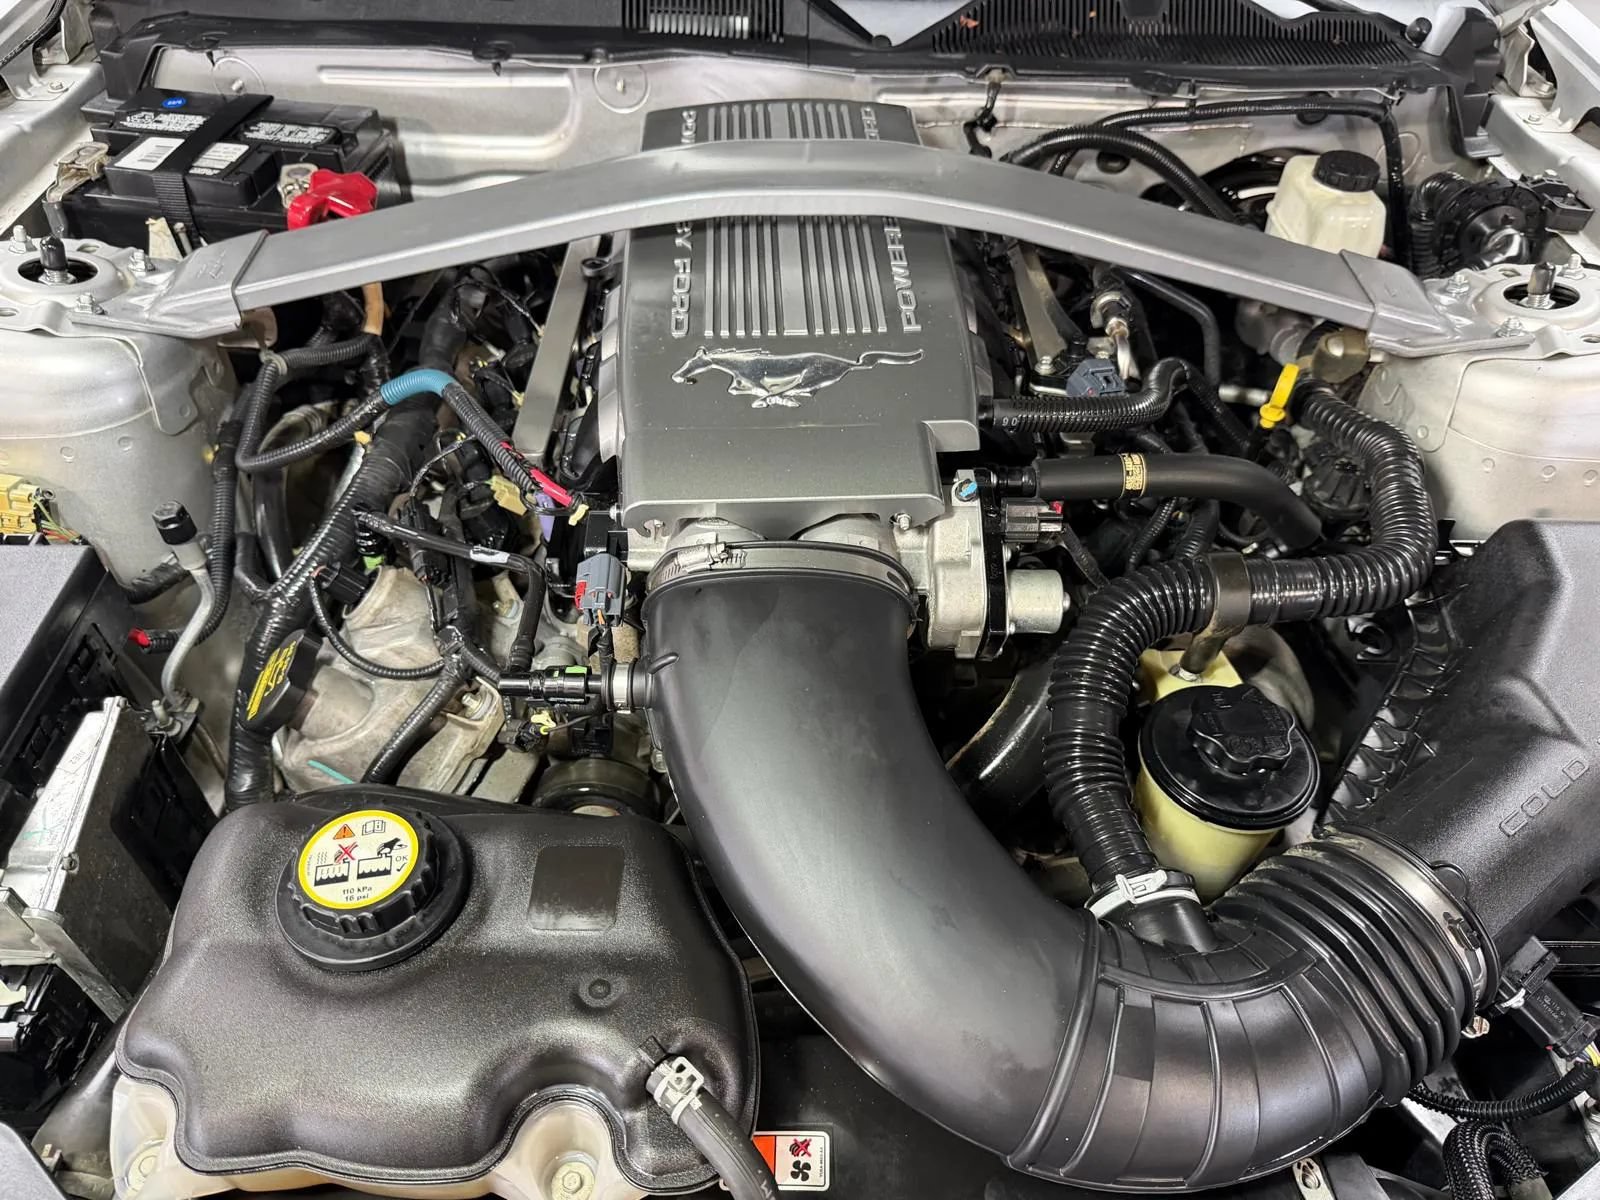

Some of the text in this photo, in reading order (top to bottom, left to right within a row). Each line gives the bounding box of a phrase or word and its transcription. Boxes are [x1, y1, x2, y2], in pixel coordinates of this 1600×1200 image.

[882, 216, 922, 333] POWERE
[670, 257, 692, 340] FORD
[1499, 757, 1590, 837] COLD
[395, 854, 409, 863] OK
[342, 885, 373, 895] 110 kPa
[344, 893, 370, 903] 16 psi
